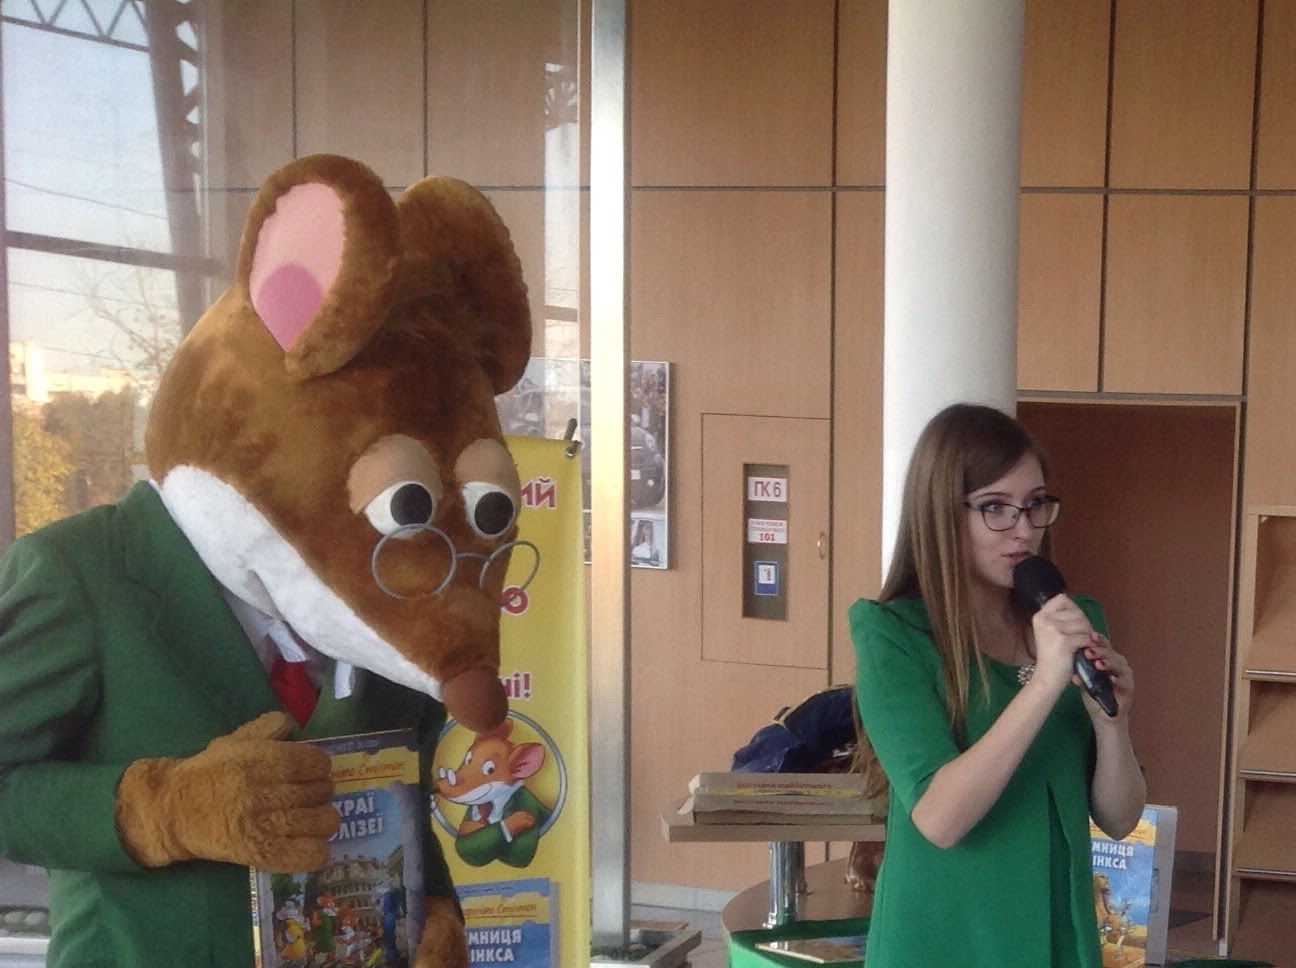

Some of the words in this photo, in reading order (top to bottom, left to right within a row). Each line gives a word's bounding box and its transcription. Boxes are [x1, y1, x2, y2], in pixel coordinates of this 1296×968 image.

[773, 481, 782, 498] 6
[759, 532, 776, 542] 101
[328, 813, 383, 842] ЛІЗЕЇ
